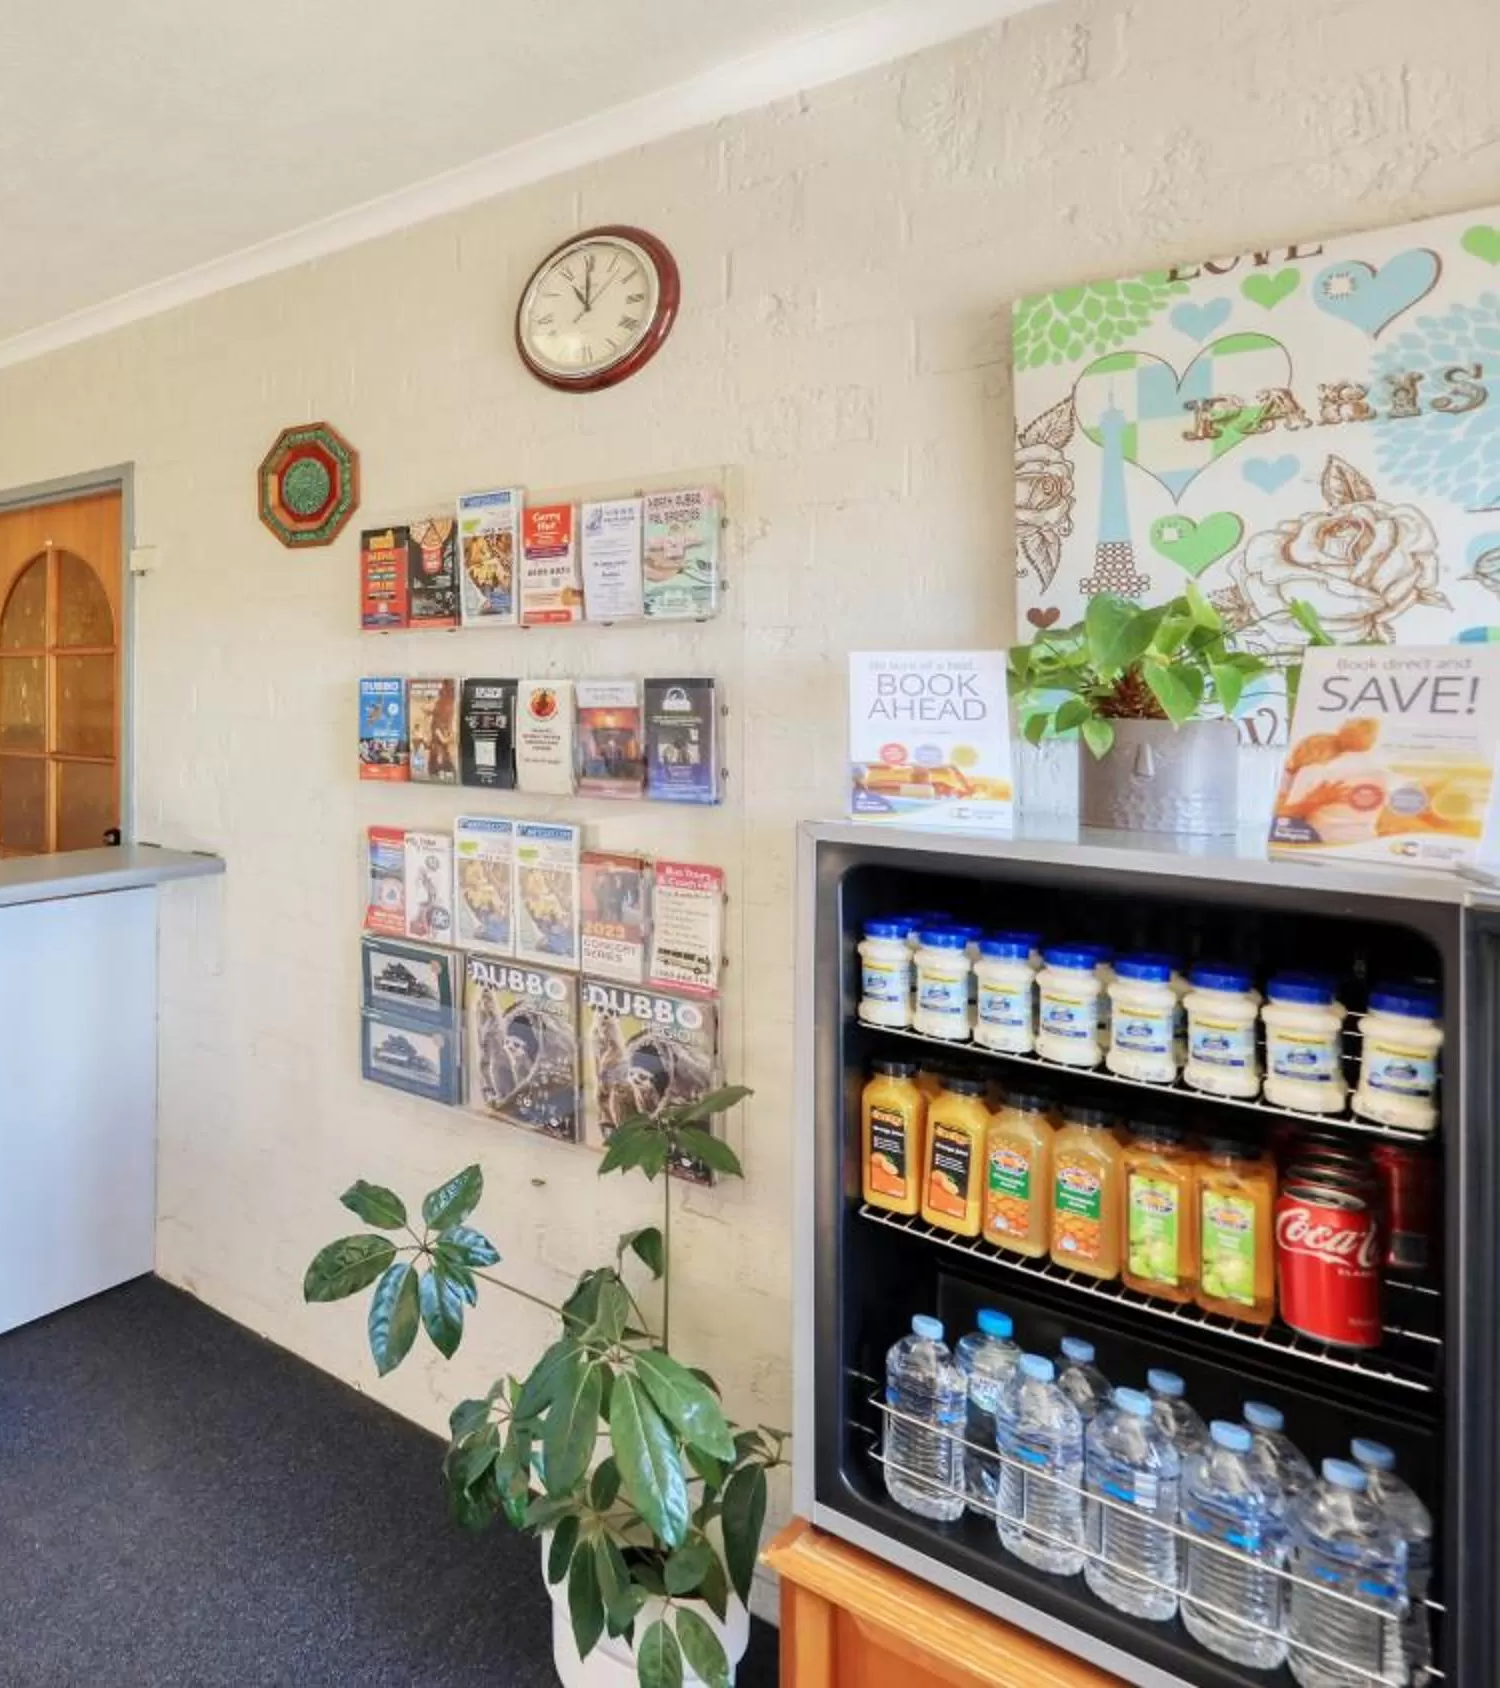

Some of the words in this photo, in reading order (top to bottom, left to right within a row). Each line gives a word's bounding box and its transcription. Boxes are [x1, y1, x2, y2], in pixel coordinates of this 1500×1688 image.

[1182, 362, 1488, 442] PARIS
[1337, 657, 1378, 671] Book
[1383, 657, 1432, 670] direct
[1436, 657, 1474, 670] and
[876, 672, 980, 697] BOOK
[1316, 675, 1480, 715] SAVE!
[868, 697, 987, 721] AHEAD
[471, 960, 567, 1001] DUBBO
[588, 983, 703, 1030] DUBBO
